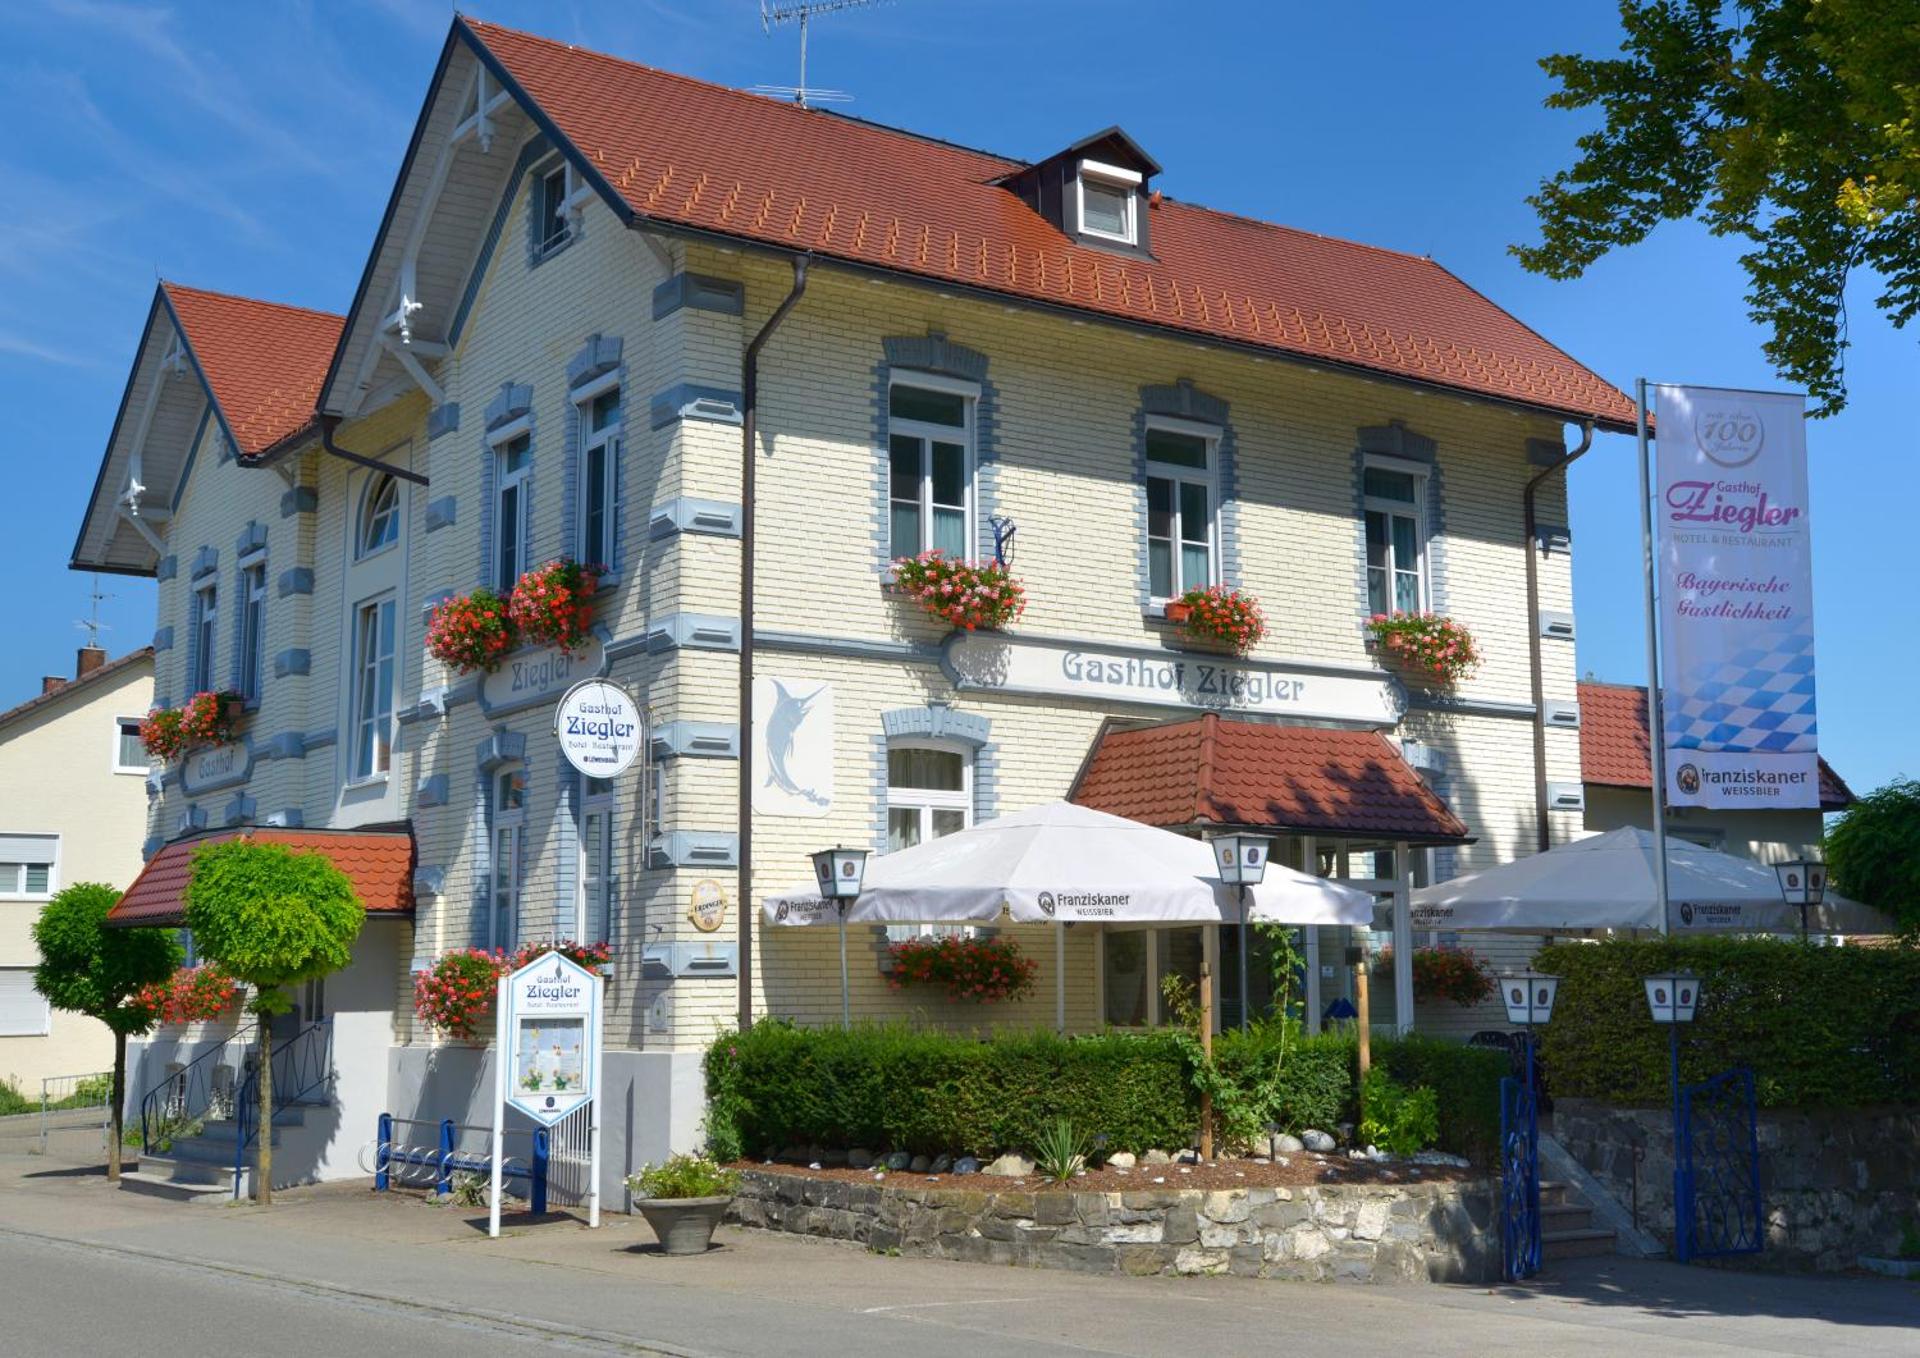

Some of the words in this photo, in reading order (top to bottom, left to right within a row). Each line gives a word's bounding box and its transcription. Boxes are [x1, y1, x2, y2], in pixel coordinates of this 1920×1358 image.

[1704, 421, 1757, 442] 100
[1717, 480, 1761, 498] Gasthof
[1666, 481, 1799, 533] Ziegler
[1674, 534, 1708, 544] HOTEL
[1722, 535, 1793, 548] RESTAURANT
[1677, 572, 1790, 597] Bayerische
[1677, 598, 1792, 621] Gastlichkeit
[512, 653, 573, 692] Ziegler
[1062, 651, 1185, 692] Gasthof
[1196, 664, 1304, 704] Ziegler
[579, 702, 622, 715] Gasthof
[566, 716, 634, 740] Ziegler
[1722, 786, 1780, 796] WEISSBIER
[1057, 893, 1130, 906] Franziskaner
[1077, 908, 1114, 916] WEISSBIER
[526, 985, 580, 1001] Ziegler
